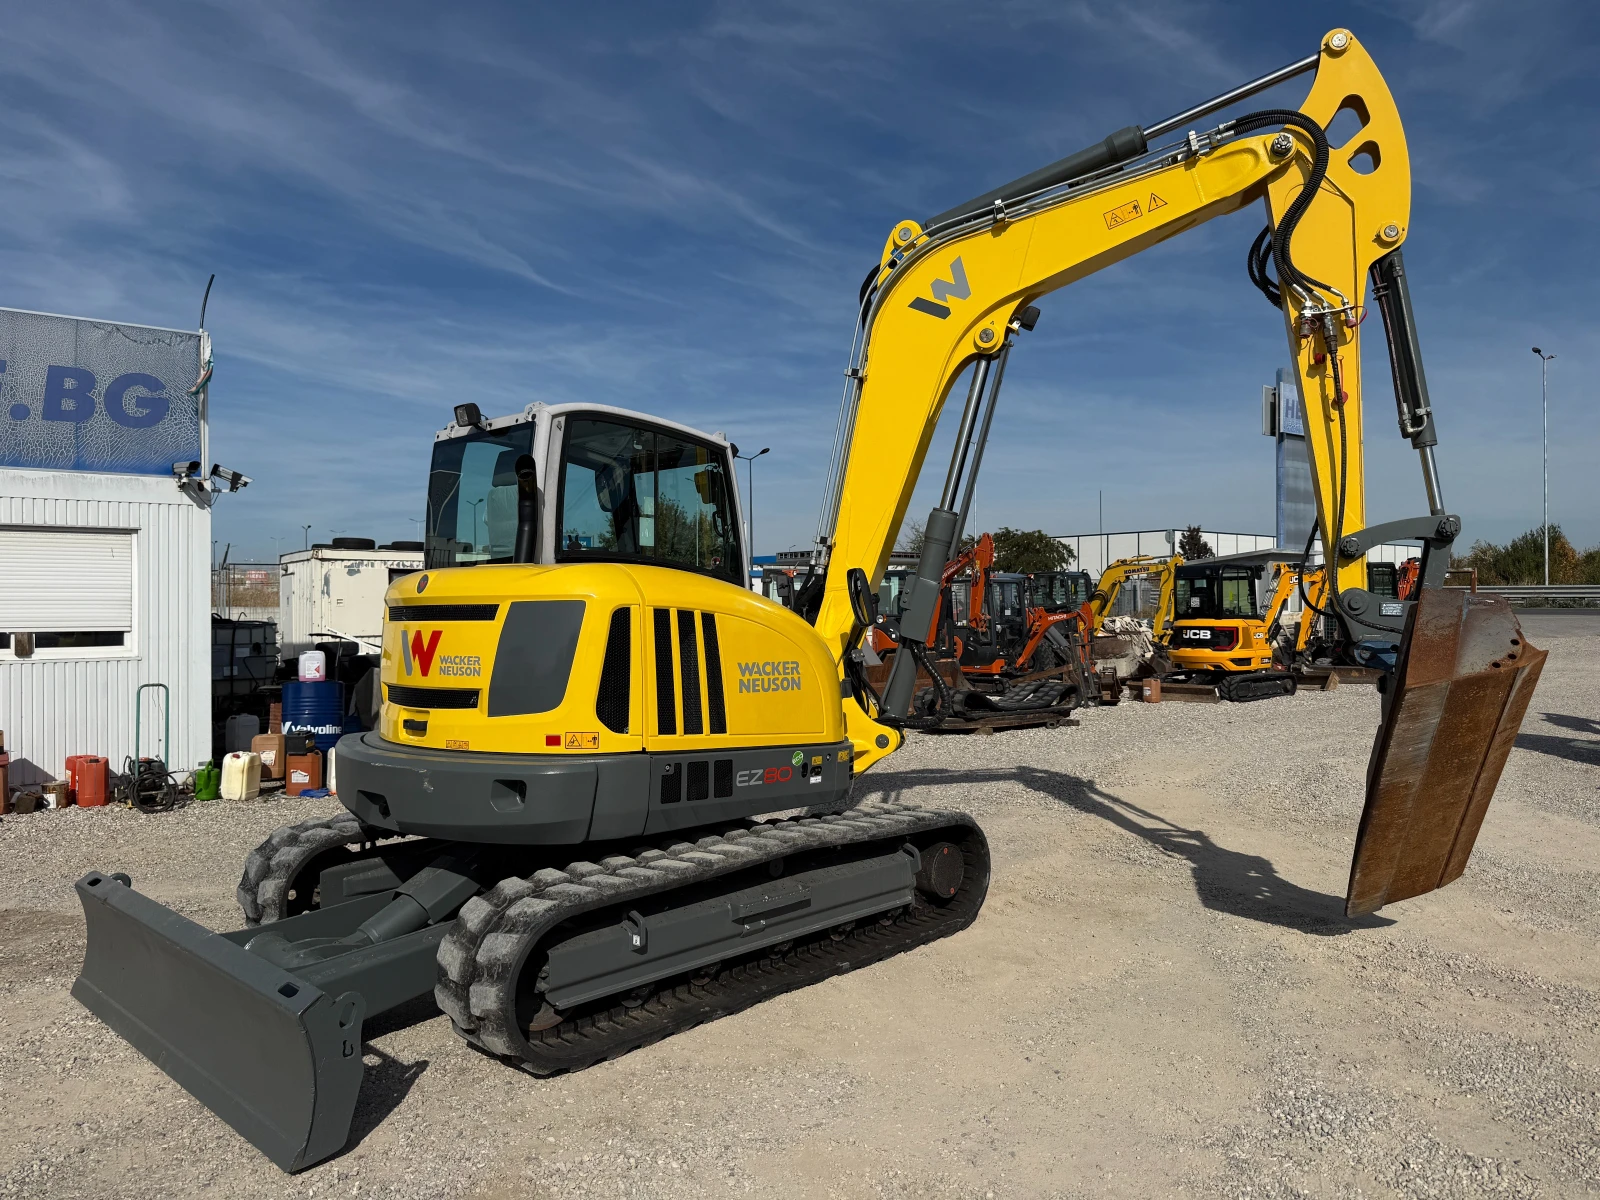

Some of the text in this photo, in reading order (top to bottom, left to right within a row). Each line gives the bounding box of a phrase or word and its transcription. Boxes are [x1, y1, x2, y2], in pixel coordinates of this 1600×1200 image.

[0, 360, 170, 429] .BG
[1123, 566, 1150, 575] KOMATSU
[1289, 576, 1299, 584] JC
[1182, 629, 1212, 640] JCB
[439, 655, 481, 667] WACKER
[439, 666, 481, 677] NEUSON
[737, 660, 801, 677] WACKER
[738, 676, 801, 694] NEUSON
[736, 766, 793, 787] EZ80
